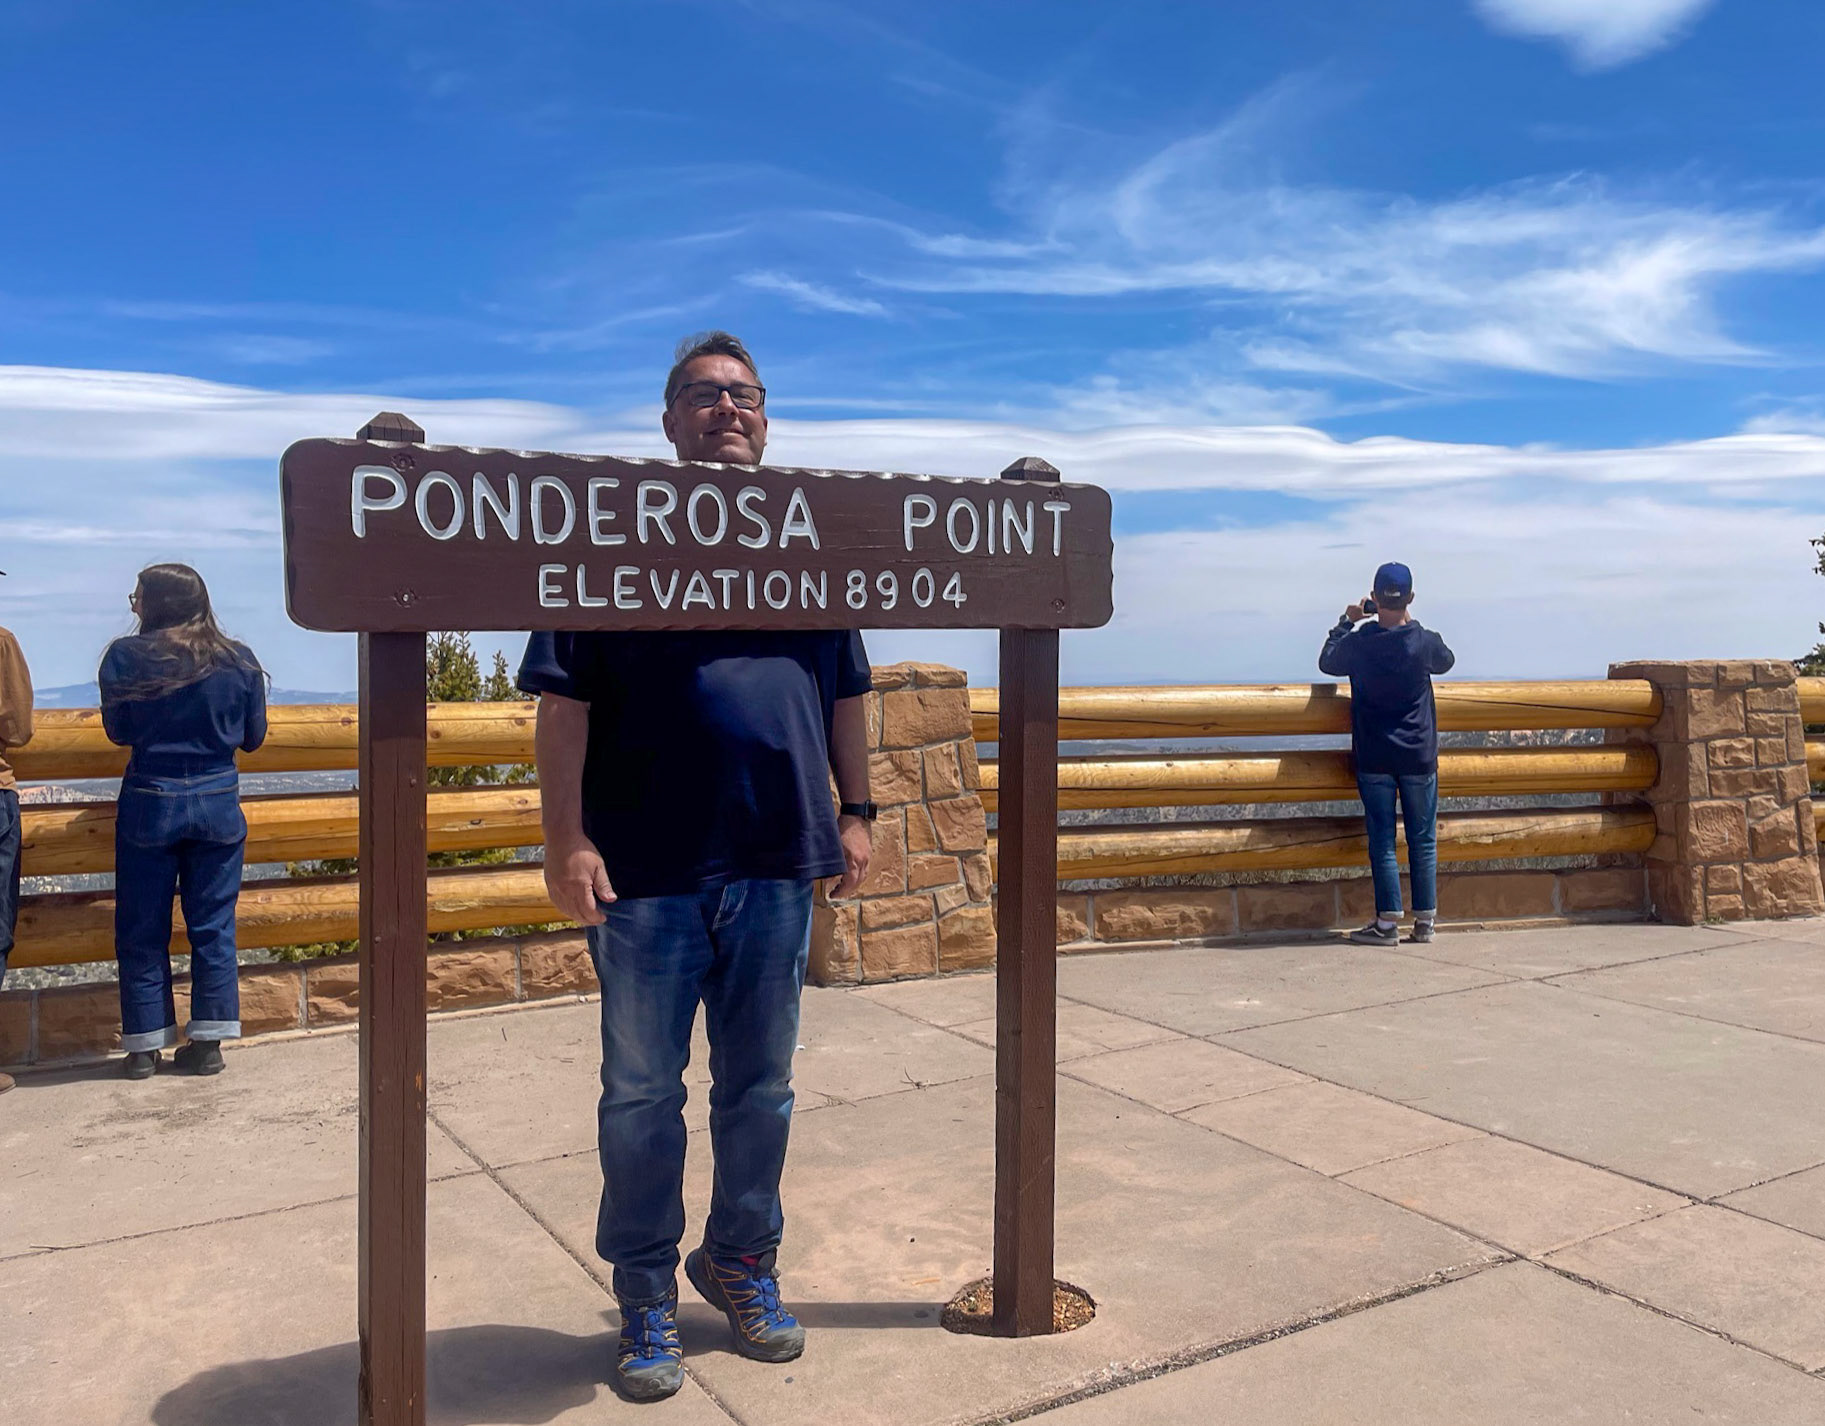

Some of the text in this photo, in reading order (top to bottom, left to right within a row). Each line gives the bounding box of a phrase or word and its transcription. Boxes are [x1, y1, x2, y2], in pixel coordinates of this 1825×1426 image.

[350, 465, 1071, 558] PONDEROSA POINT
[538, 563, 968, 611] ELEVATION 8904
